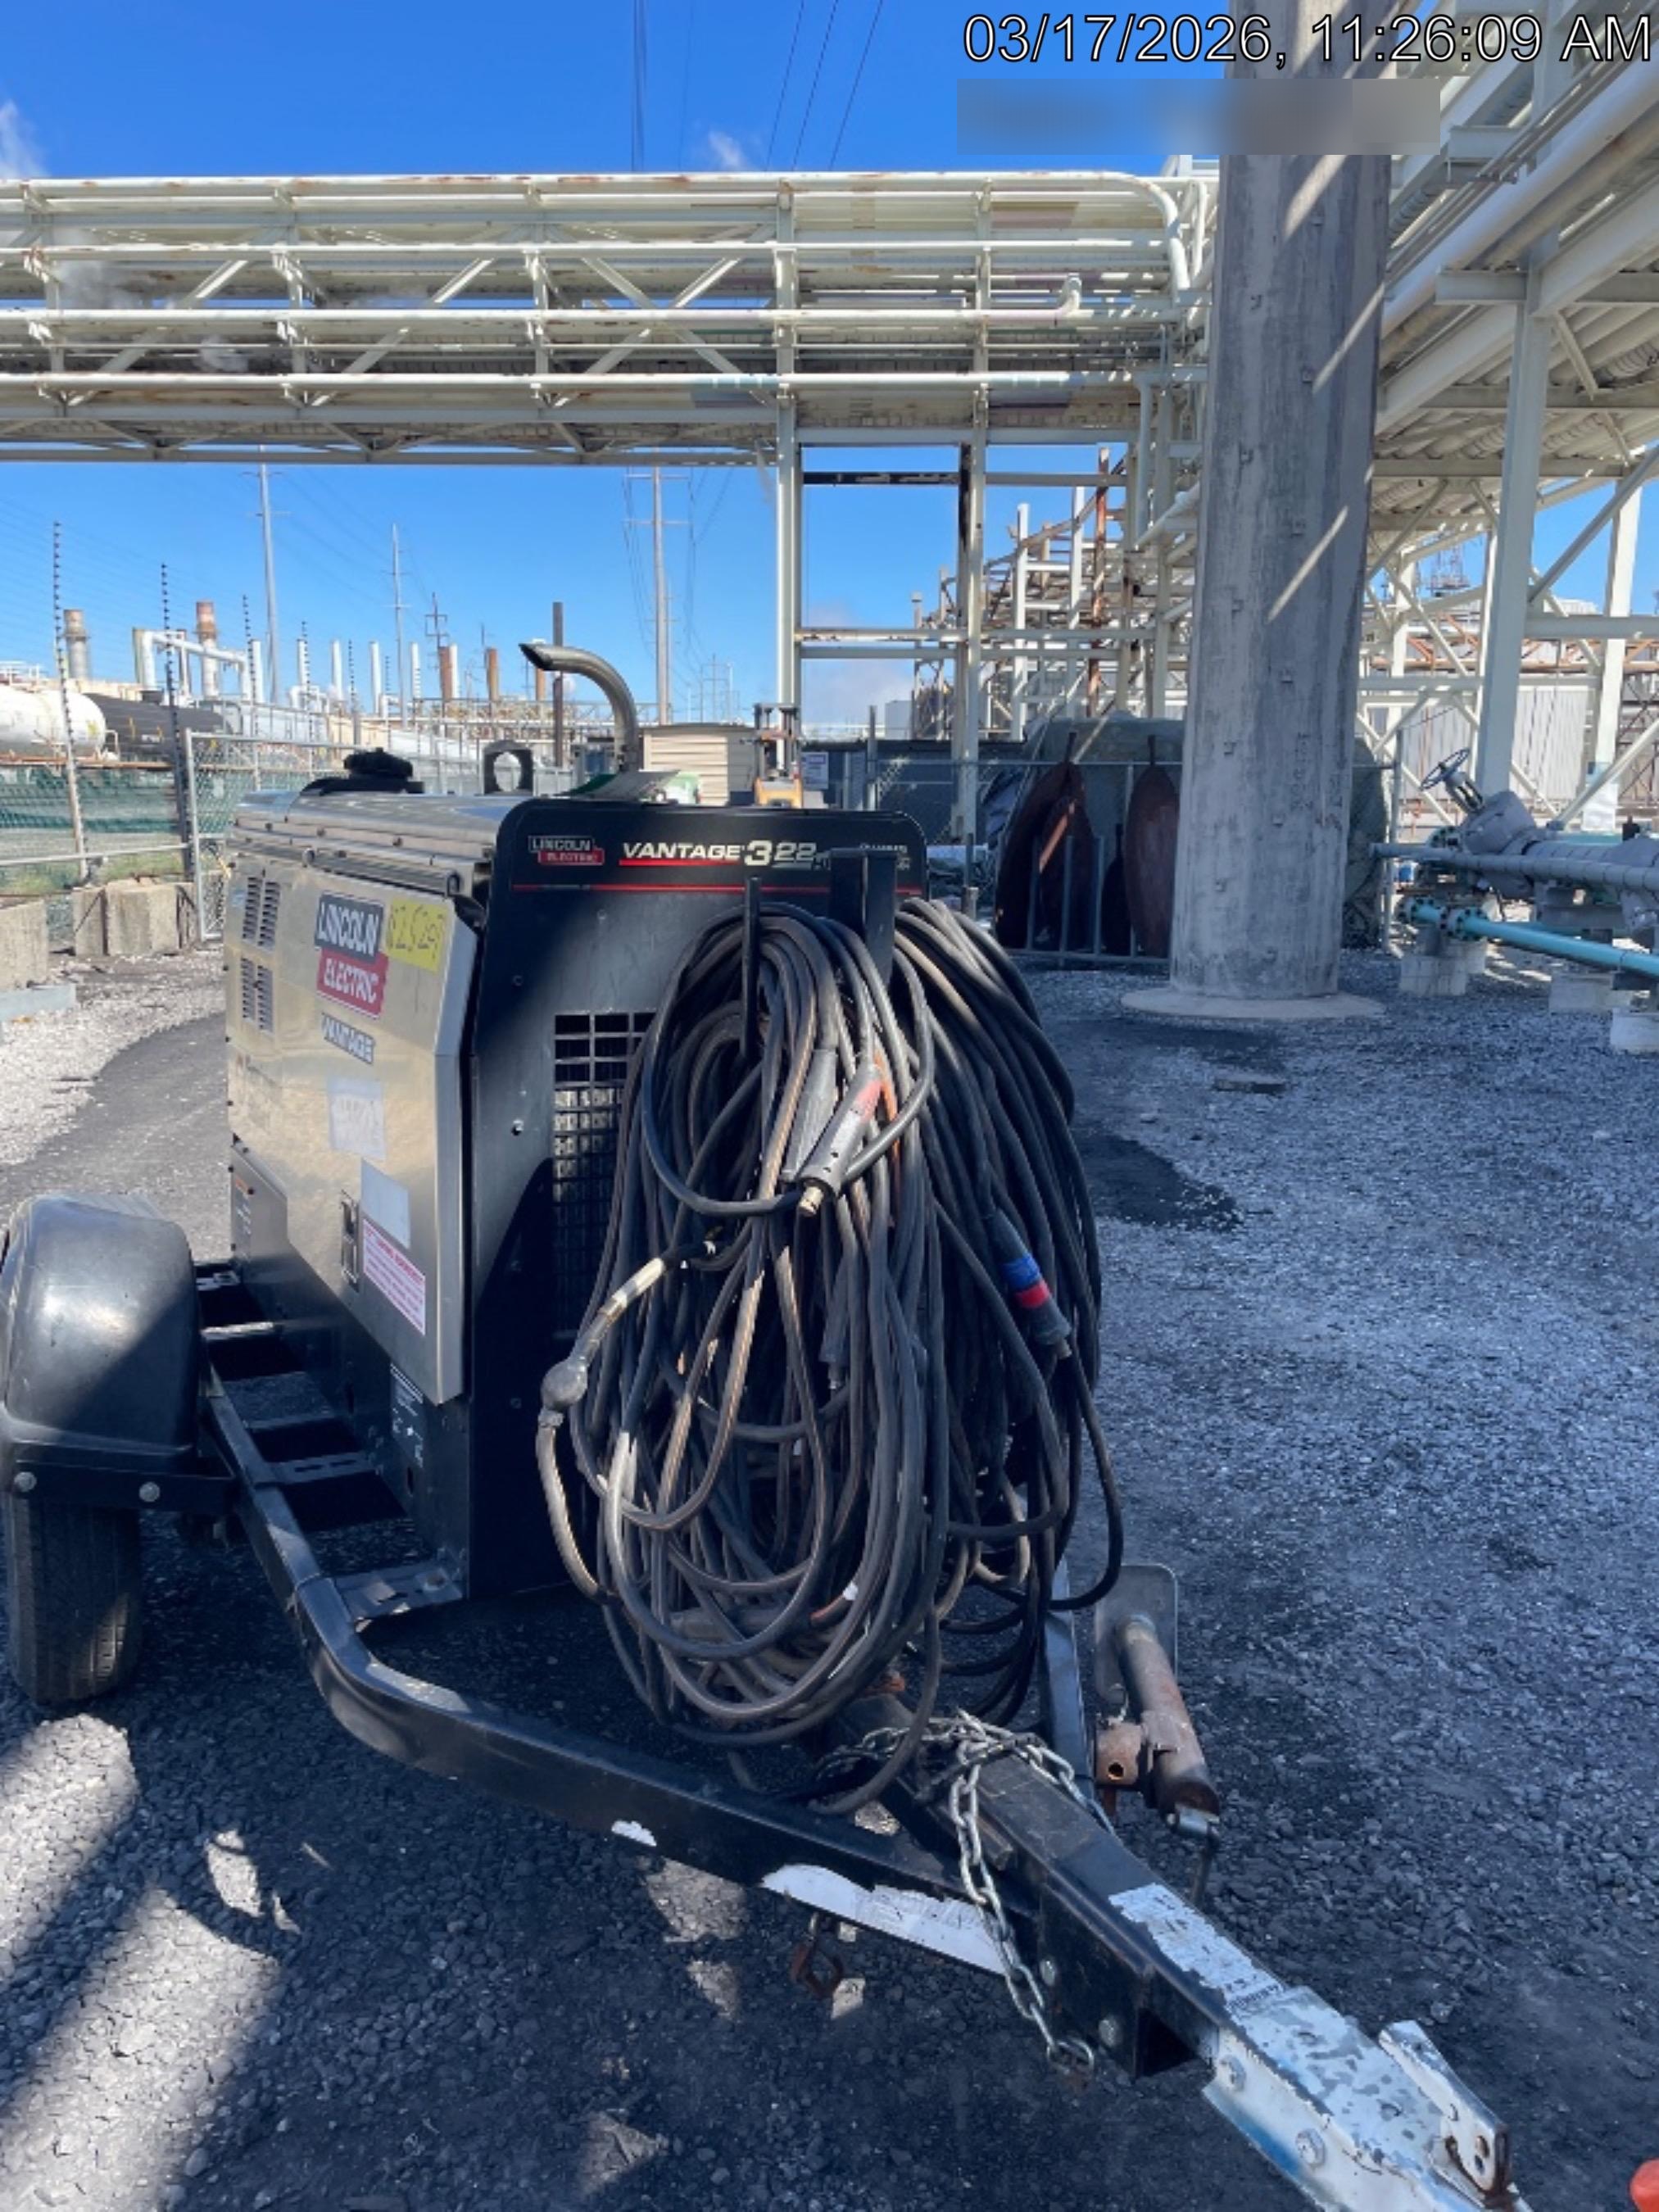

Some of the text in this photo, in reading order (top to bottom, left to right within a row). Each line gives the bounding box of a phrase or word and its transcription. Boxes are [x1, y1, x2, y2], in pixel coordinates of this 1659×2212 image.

[532, 837, 591, 851] LINCOLN
[623, 842, 741, 859] VANTAGE
[318, 902, 379, 957] LINCOLN
[324, 958, 379, 1004] ELECTRIC
[323, 1014, 375, 1063] VANTAGE
